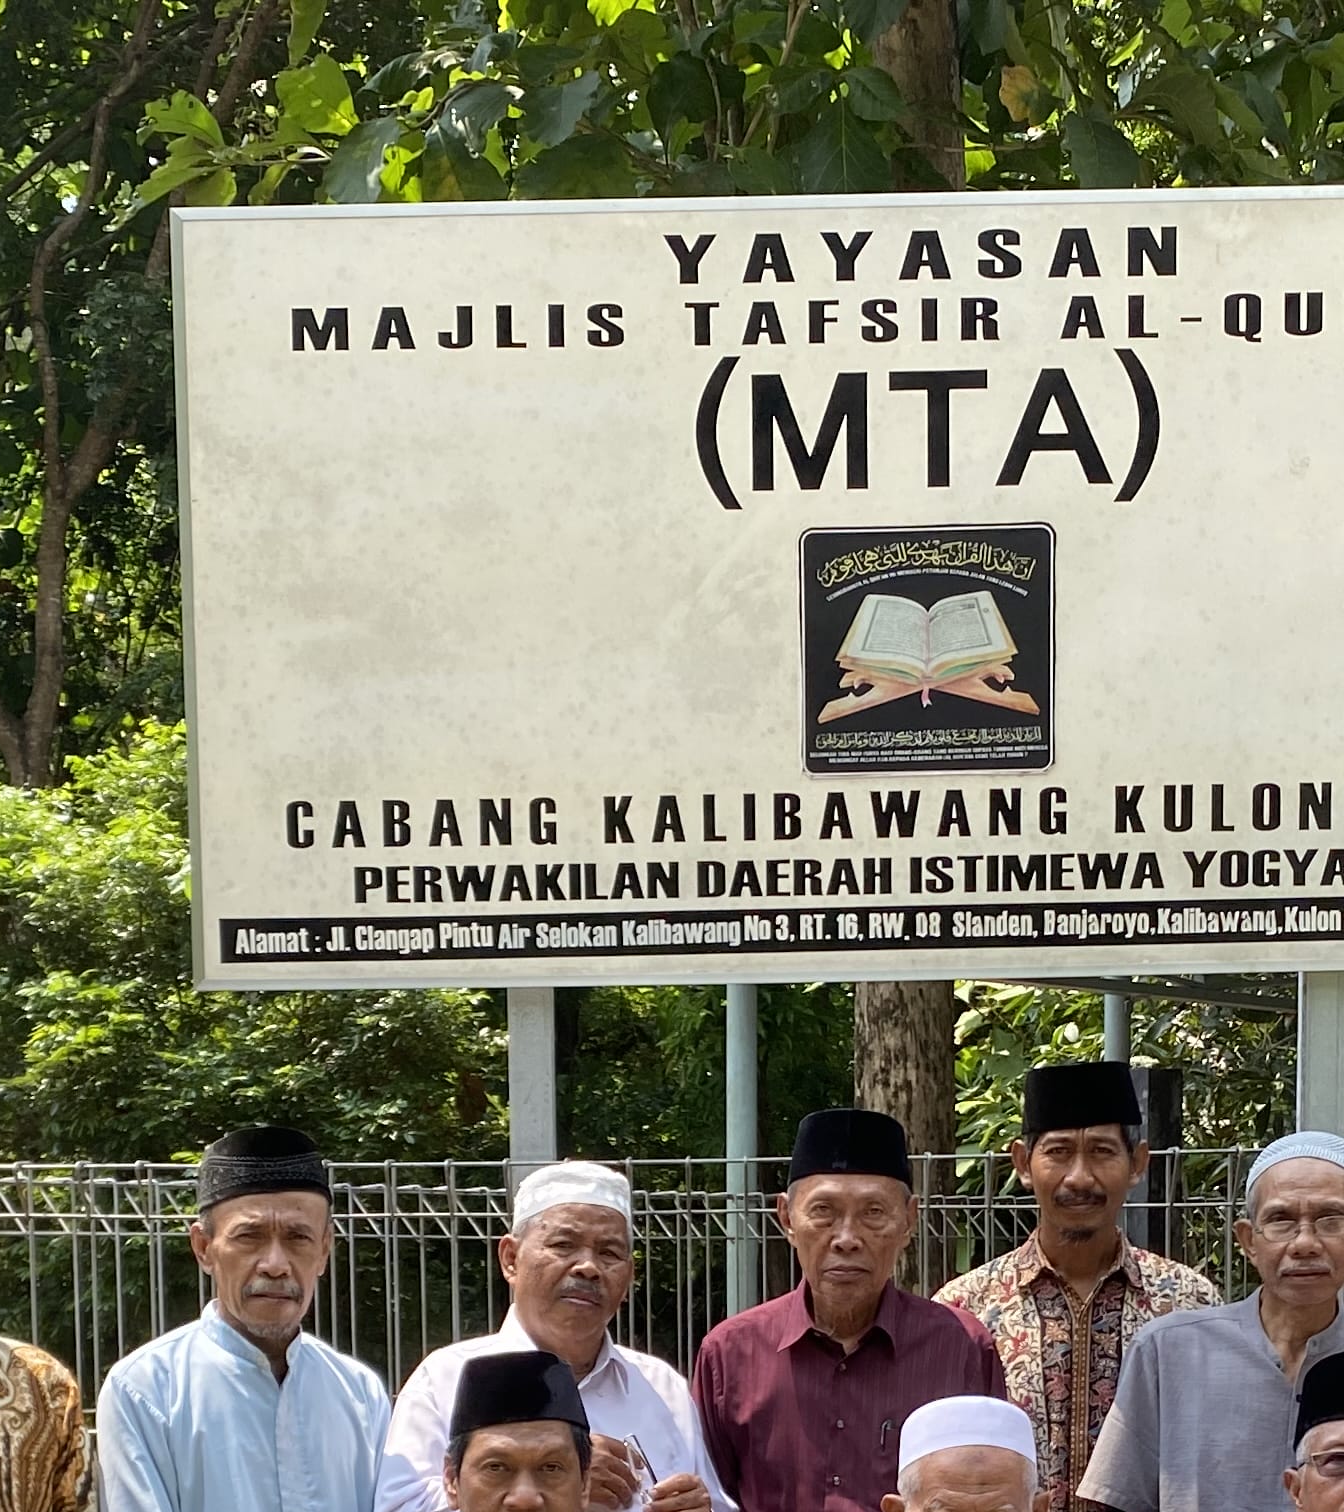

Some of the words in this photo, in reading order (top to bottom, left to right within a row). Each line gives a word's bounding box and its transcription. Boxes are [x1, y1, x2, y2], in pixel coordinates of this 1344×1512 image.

[663, 226, 1177, 285] YAYASAN
[291, 303, 625, 351] MAJLIS
[684, 297, 1000, 346] TAFSIR
[695, 348, 1160, 510] (MTA)
[286, 797, 557, 849] CABANG
[603, 786, 1067, 844] KALIBAWANG
[1114, 782, 1332, 834] KULON
[354, 861, 680, 904] PERWAKILAN
[696, 856, 892, 898] DAERAH
[909, 851, 1165, 894] ISTIMEWA
[235, 928, 310, 955] Alamat
[325, 926, 351, 952] Jl.
[439, 922, 494, 949] Pintu
[497, 923, 531, 950] Air
[535, 921, 618, 949] Selokan
[622, 919, 741, 946] Kalibawang
[743, 914, 772, 942] No
[799, 913, 832, 941] RT.
[836, 912, 864, 942] 16,
[868, 912, 910, 941] RW.
